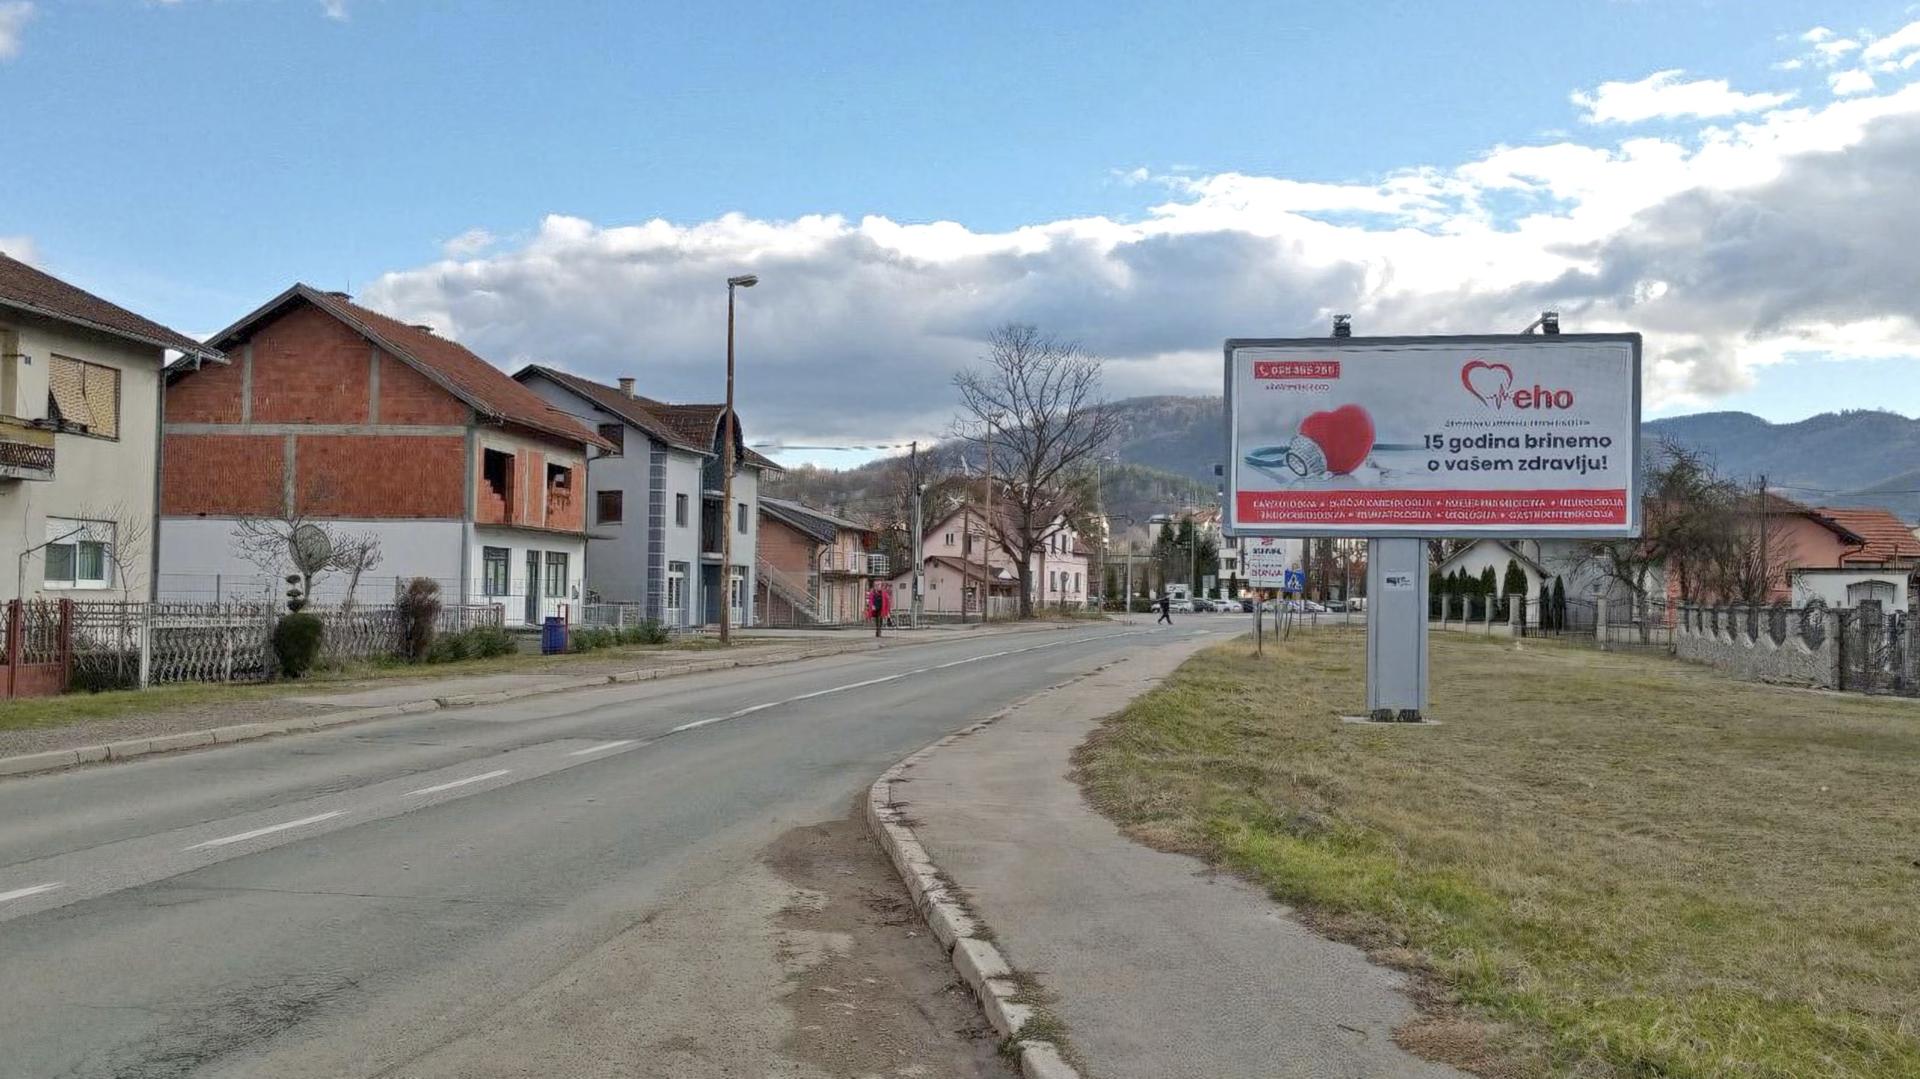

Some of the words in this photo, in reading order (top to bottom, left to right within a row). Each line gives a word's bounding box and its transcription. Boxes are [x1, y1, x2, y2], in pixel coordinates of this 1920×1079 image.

[1424, 434, 1444, 450] 15
[1449, 433, 1520, 454] godina
[1525, 433, 1612, 450] brinemo
[1427, 459, 1440, 472] o
[1445, 456, 1513, 471] vašem
[1518, 455, 1608, 475] zdravlju!
